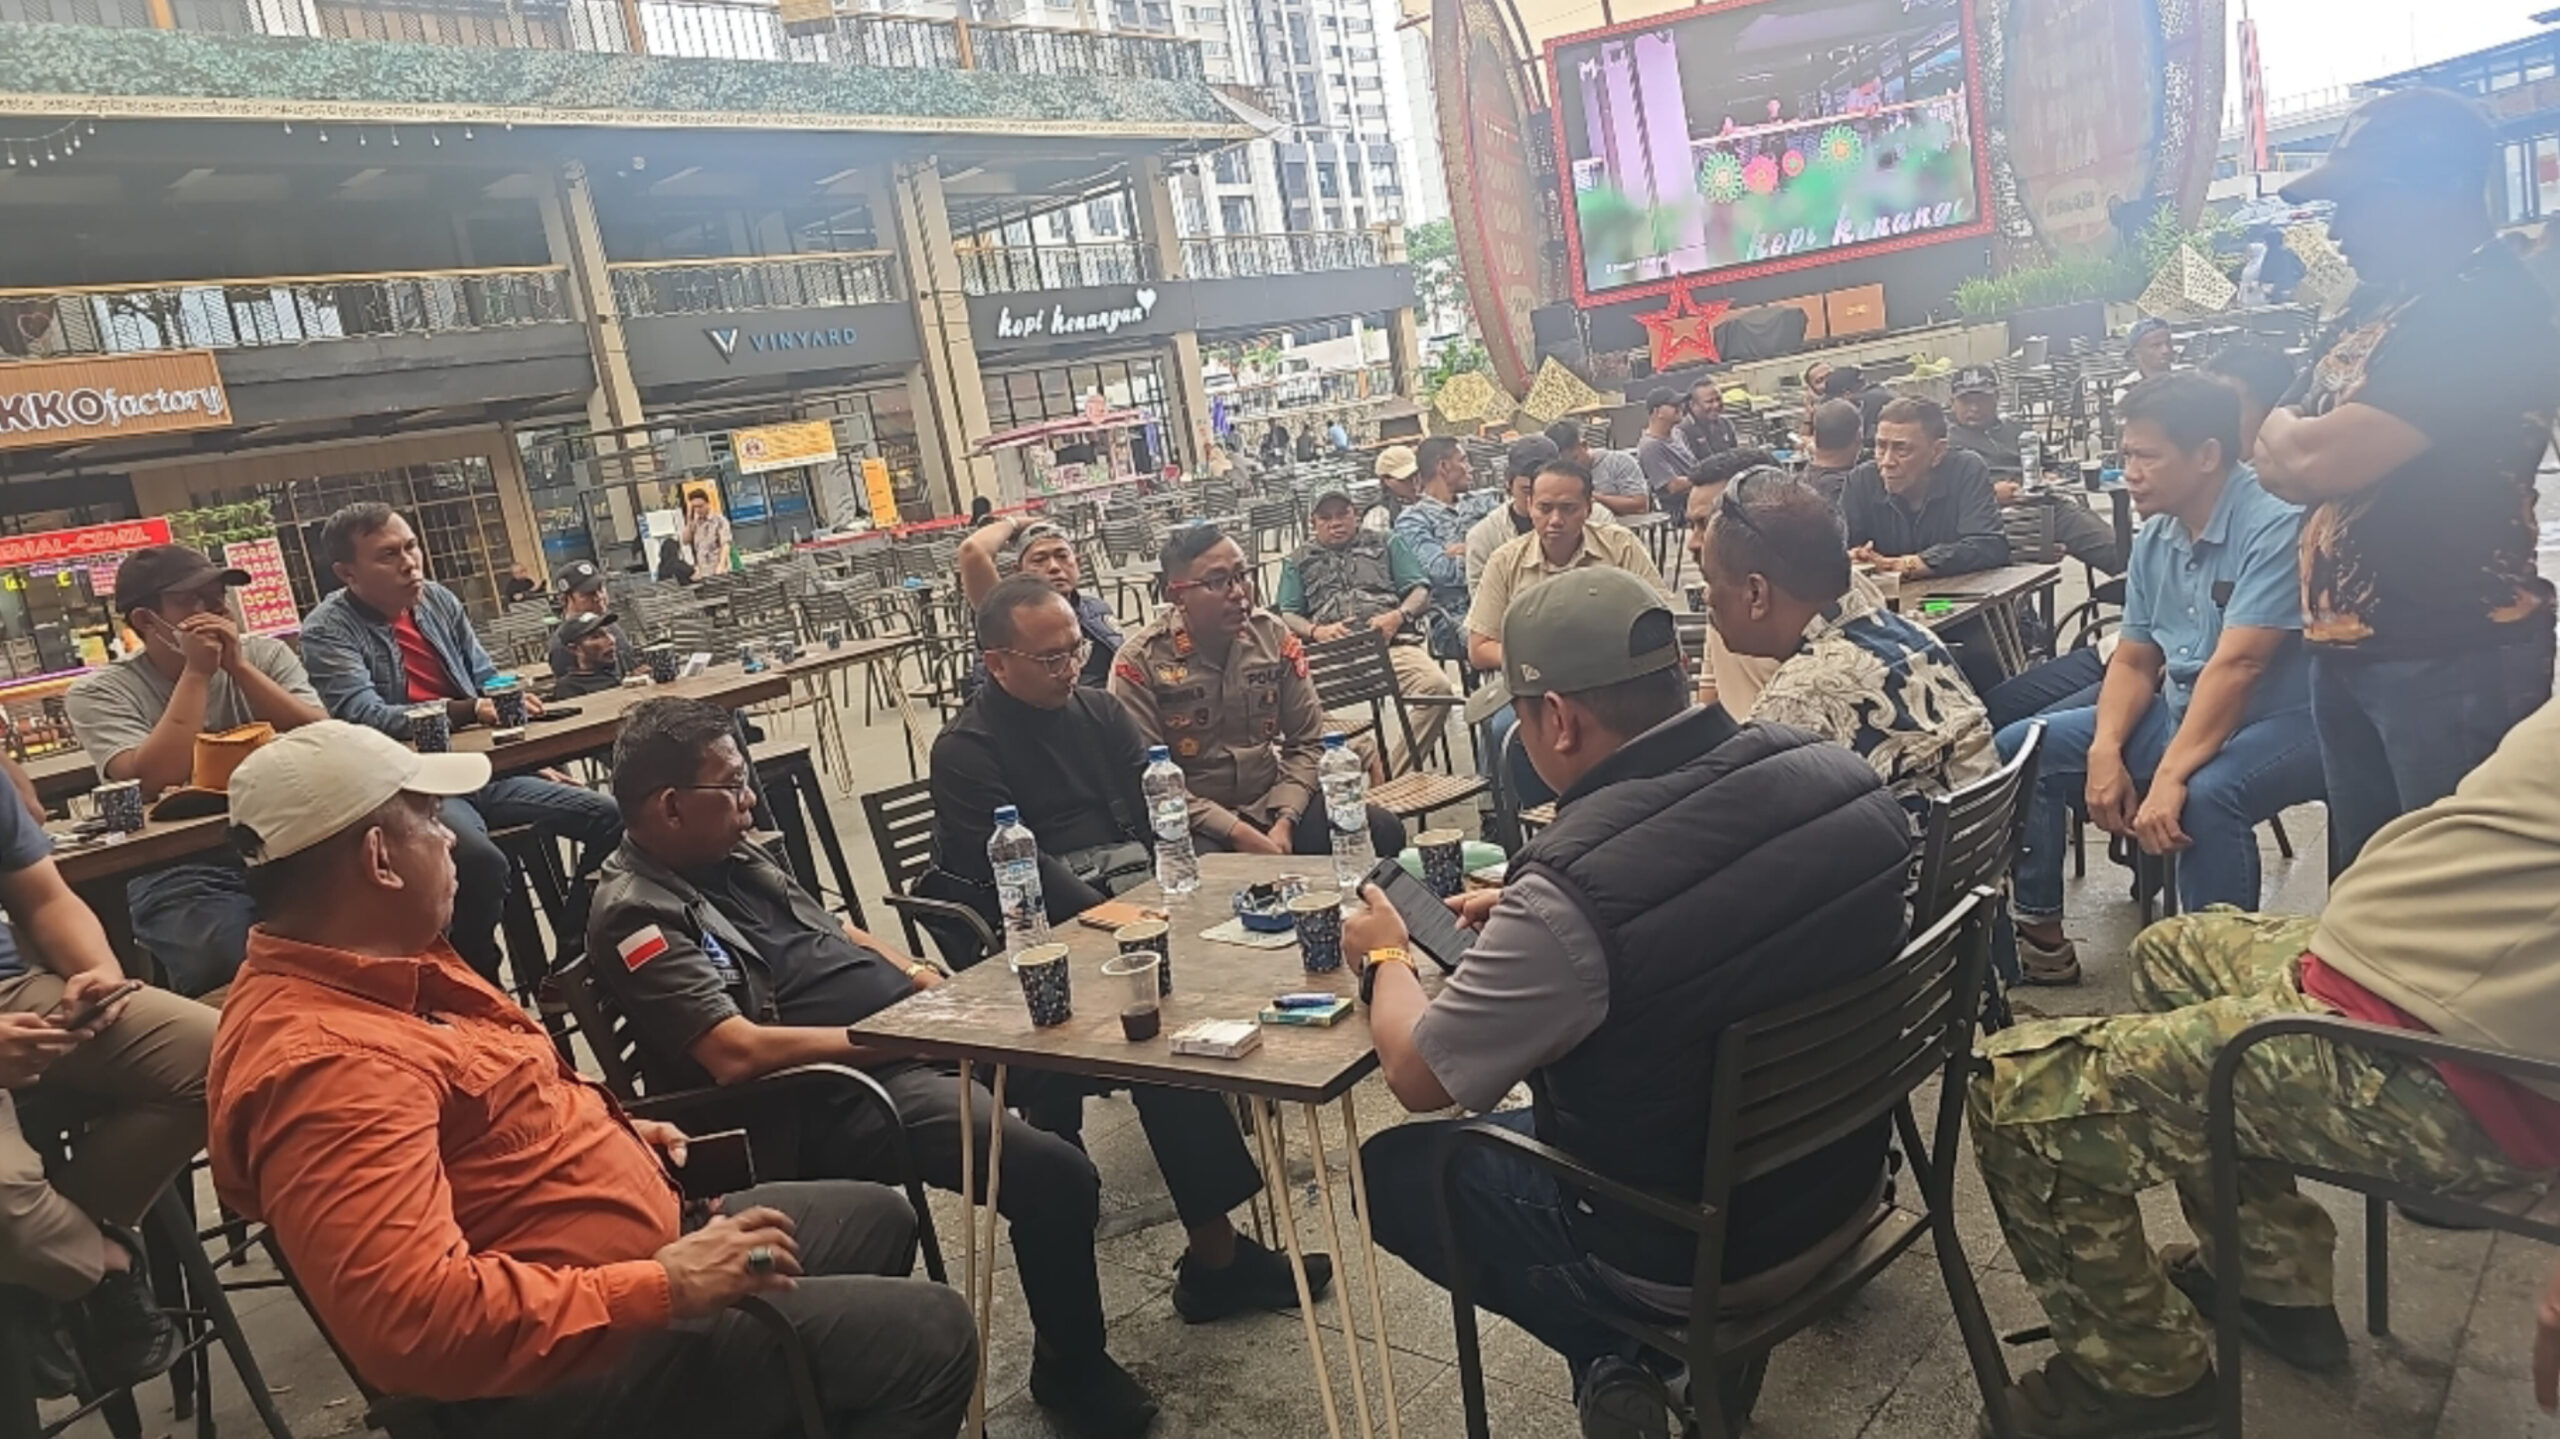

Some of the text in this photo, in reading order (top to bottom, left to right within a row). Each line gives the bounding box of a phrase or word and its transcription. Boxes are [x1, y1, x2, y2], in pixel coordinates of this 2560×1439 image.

[998, 303, 1143, 338] kopi kenangan
[750, 327, 857, 351] VINYARD
[104, 385, 224, 426] factory
